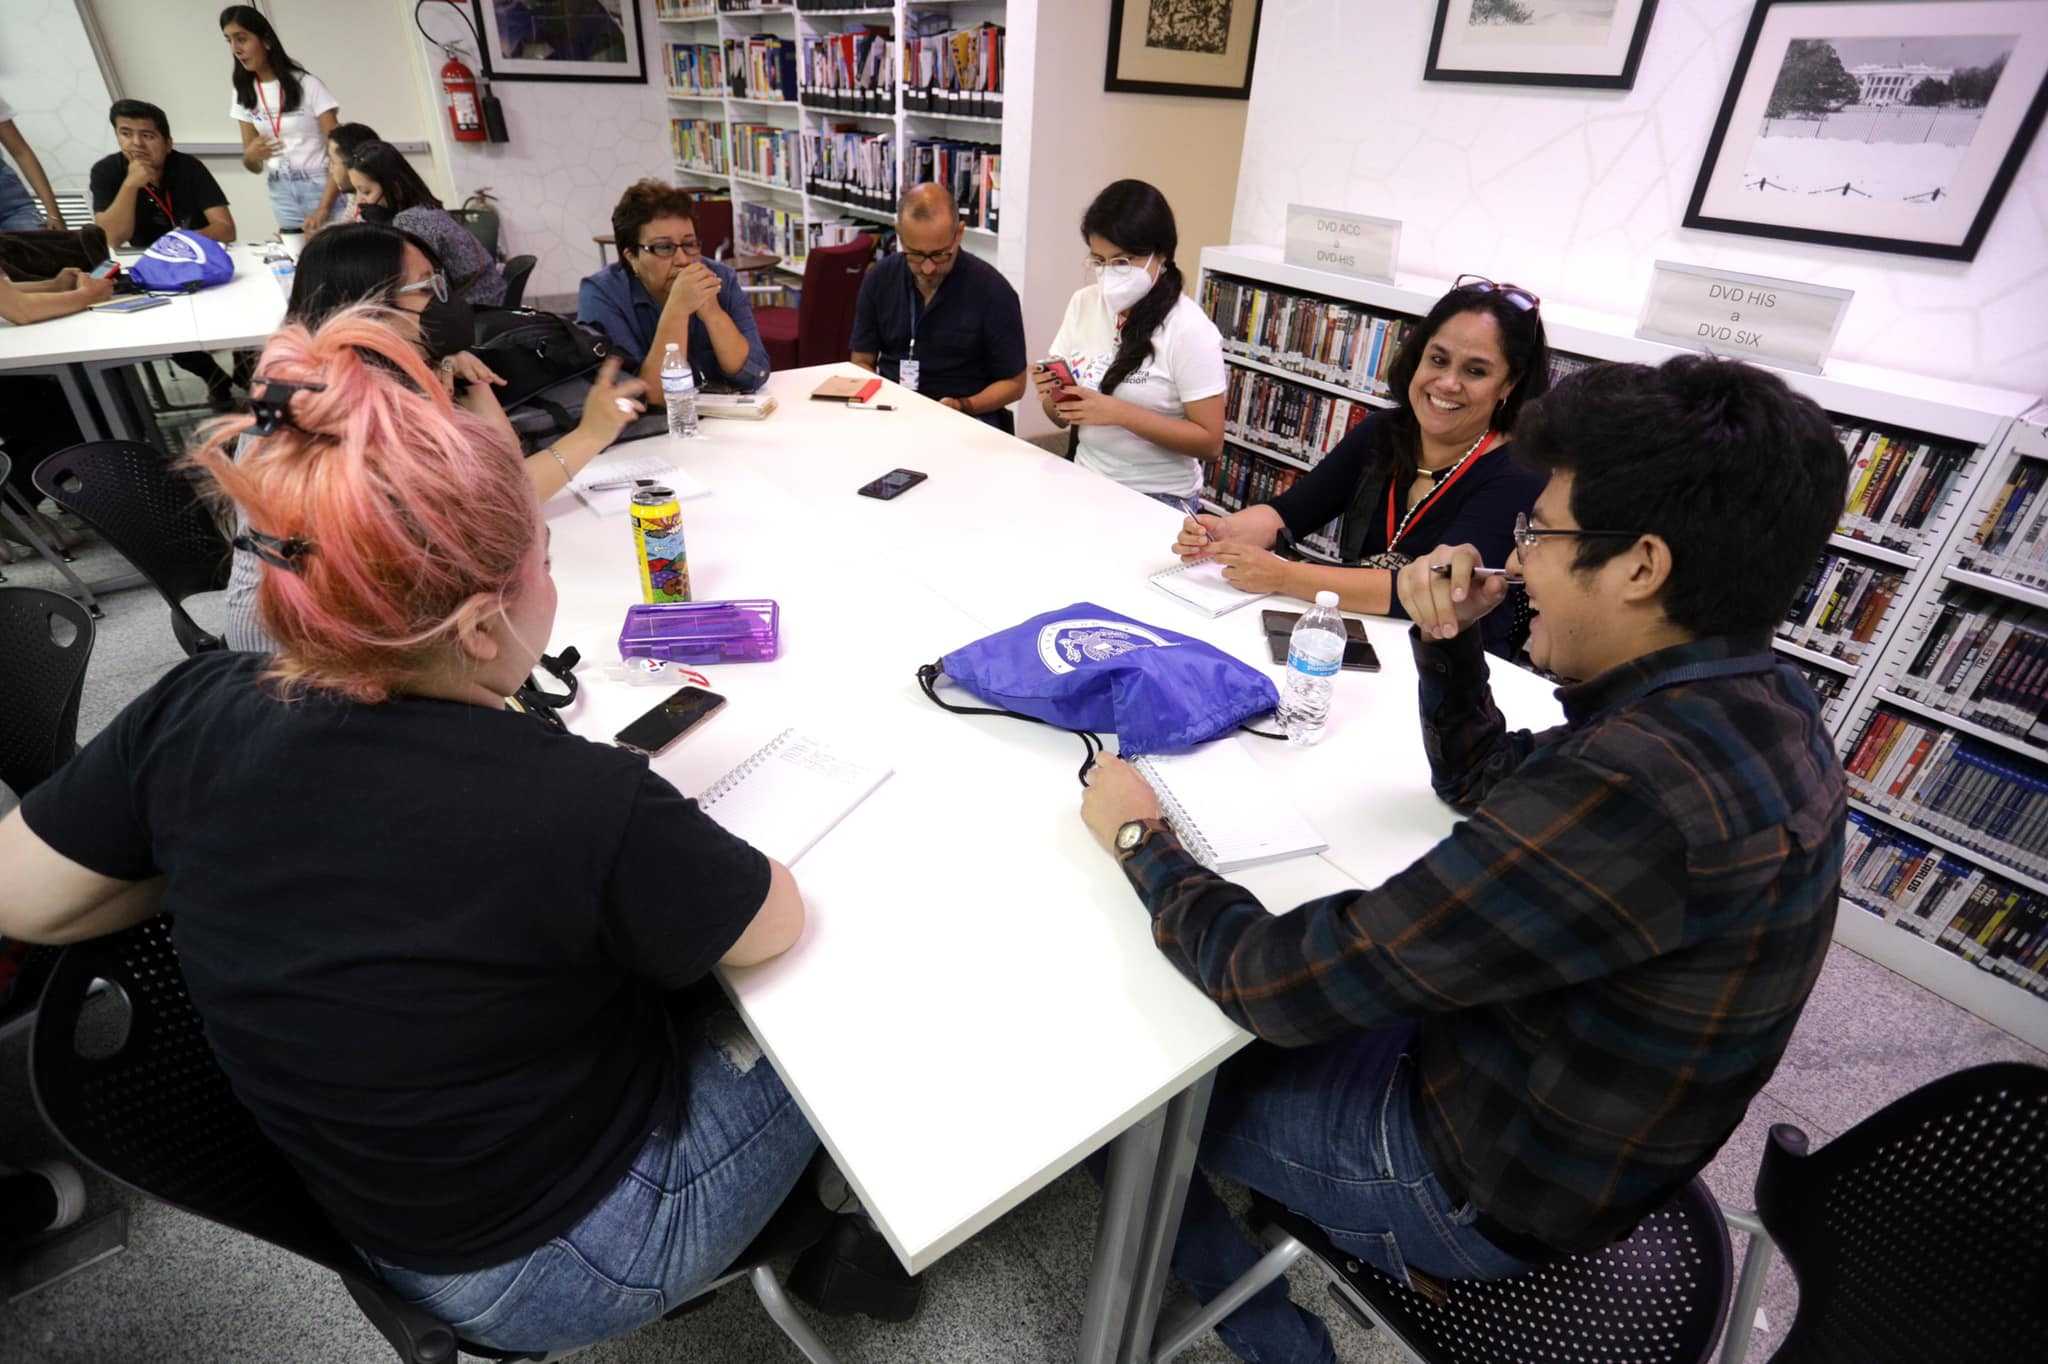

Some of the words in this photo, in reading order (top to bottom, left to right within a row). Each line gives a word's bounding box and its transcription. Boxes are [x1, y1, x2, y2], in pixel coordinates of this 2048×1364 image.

[1317, 219, 1337, 233] DVD
[1316, 250, 1337, 263] DVD
[1339, 255, 1355, 266] HIS
[1709, 284, 1743, 302] DVD
[1747, 291, 1777, 308] HIS
[1730, 312, 1740, 322] a
[1697, 323, 1731, 341] DVD
[1735, 330, 1762, 347] SIX
[1907, 857, 1937, 894] CARLOS
